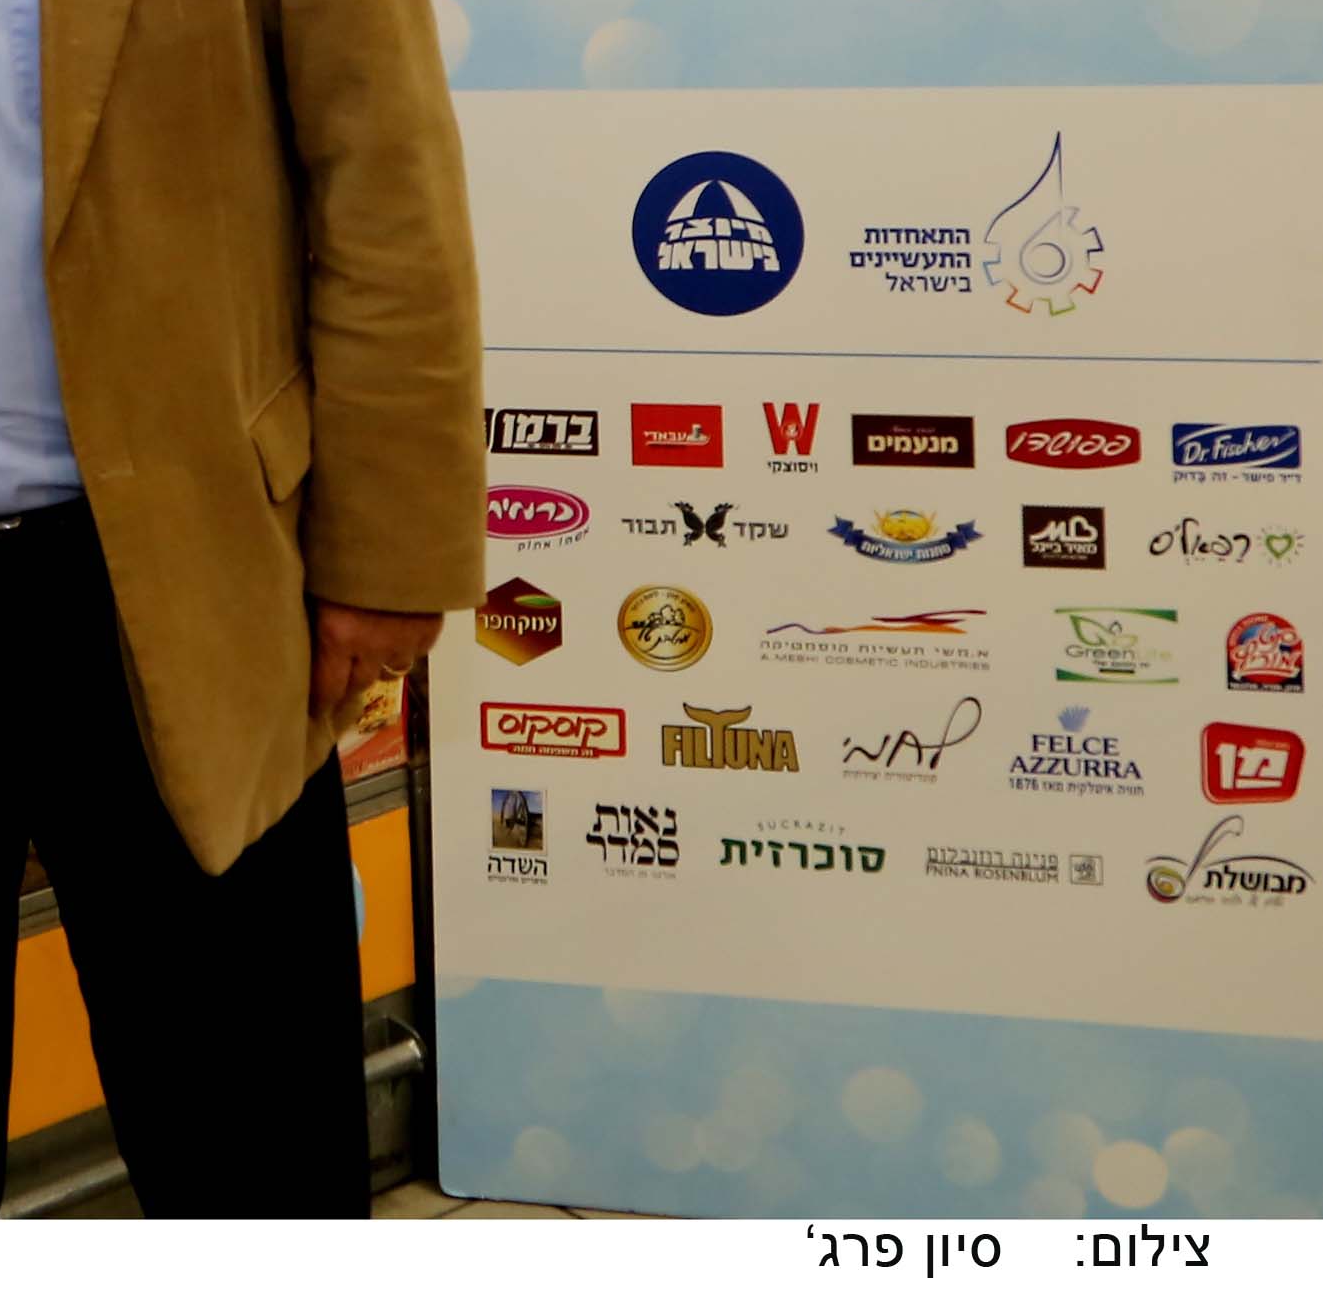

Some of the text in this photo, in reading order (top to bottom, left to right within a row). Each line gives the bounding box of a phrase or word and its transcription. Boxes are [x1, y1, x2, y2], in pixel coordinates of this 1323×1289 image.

[864, 227, 972, 246] התאחדות
[849, 250, 972, 269] התעשיינים
[885, 272, 972, 294] בישראל
[502, 412, 594, 449] ברמן
[762, 402, 821, 457] W
[867, 433, 960, 454] מנעמים
[767, 460, 819, 474] ויסוצקי
[621, 516, 789, 540] שקד תבור
[497, 712, 608, 748] קוסקוס
[660, 702, 801, 774] FILTUNA
[1031, 733, 1121, 757] FELCE
[1009, 755, 1144, 781] AZZURRA
[592, 802, 678, 838] נאות
[585, 831, 681, 867] סמדר
[719, 837, 887, 874] סוכרזית
[486, 855, 549, 877] השדה
[925, 865, 1060, 885] PNINA ROSENBLUM
[1202, 864, 1308, 895] מבושלת
